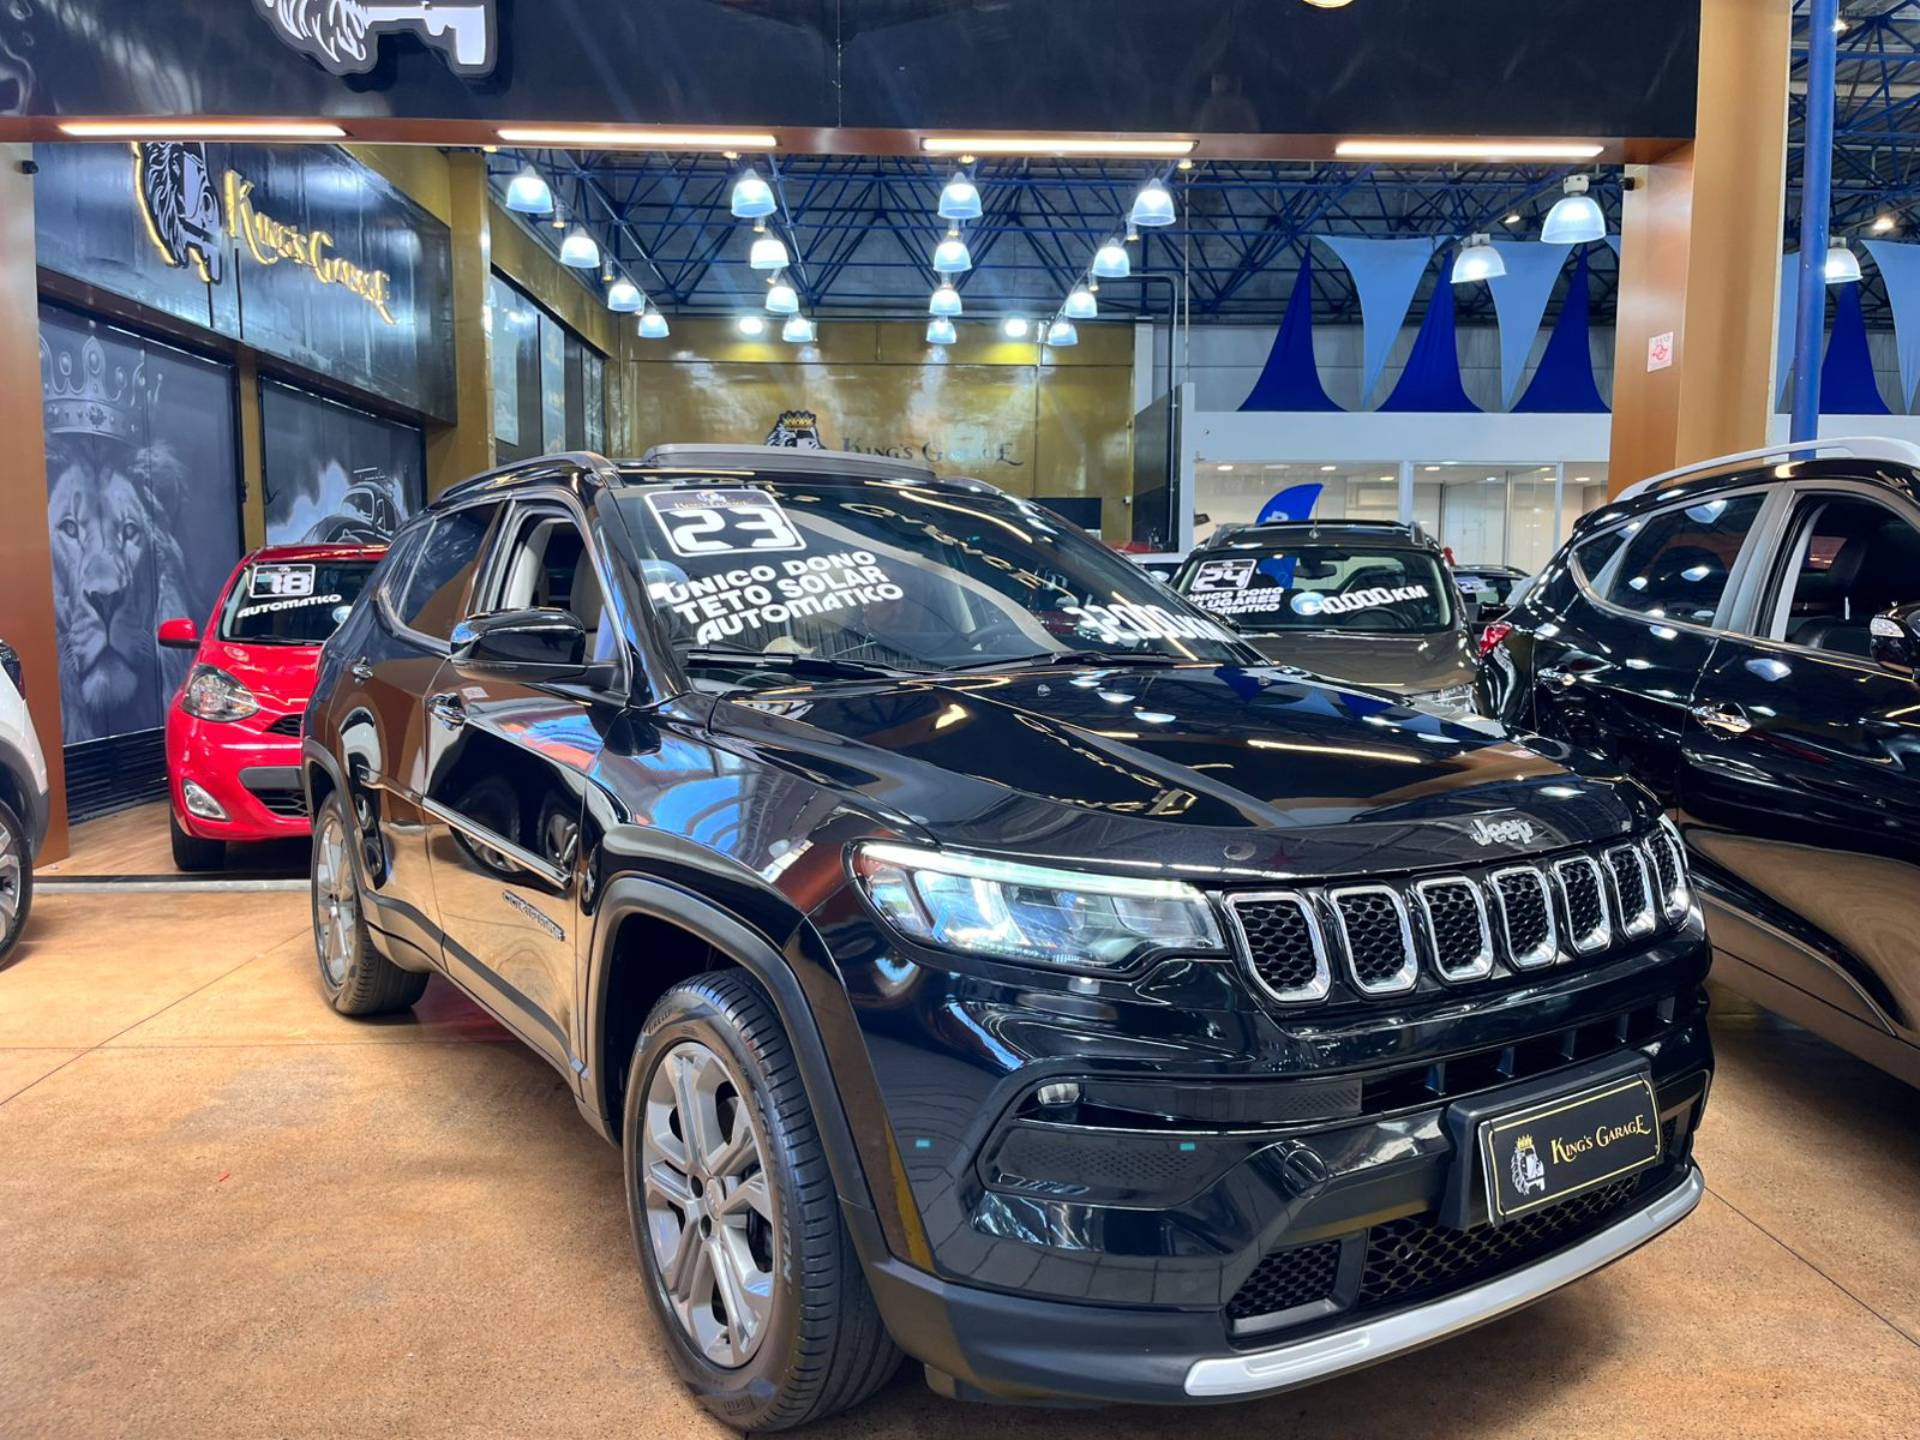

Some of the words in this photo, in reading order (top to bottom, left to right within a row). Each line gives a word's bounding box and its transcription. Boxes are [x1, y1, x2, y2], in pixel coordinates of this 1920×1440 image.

[668, 506, 797, 551] 23
[781, 550, 878, 577] DONO
[269, 572, 311, 595] 18
[1194, 568, 1250, 589] 24
[1236, 586, 1285, 598] DONO
[236, 593, 343, 618] AUTOMATICO
[673, 584, 773, 625] TETO
[776, 565, 891, 599] SOLAR
[695, 582, 905, 646] AUTOMATICO
[1470, 818, 1534, 847] Jeep
[1550, 1133, 1594, 1165] KING'S
[1595, 1114, 1652, 1147] GARAGE
